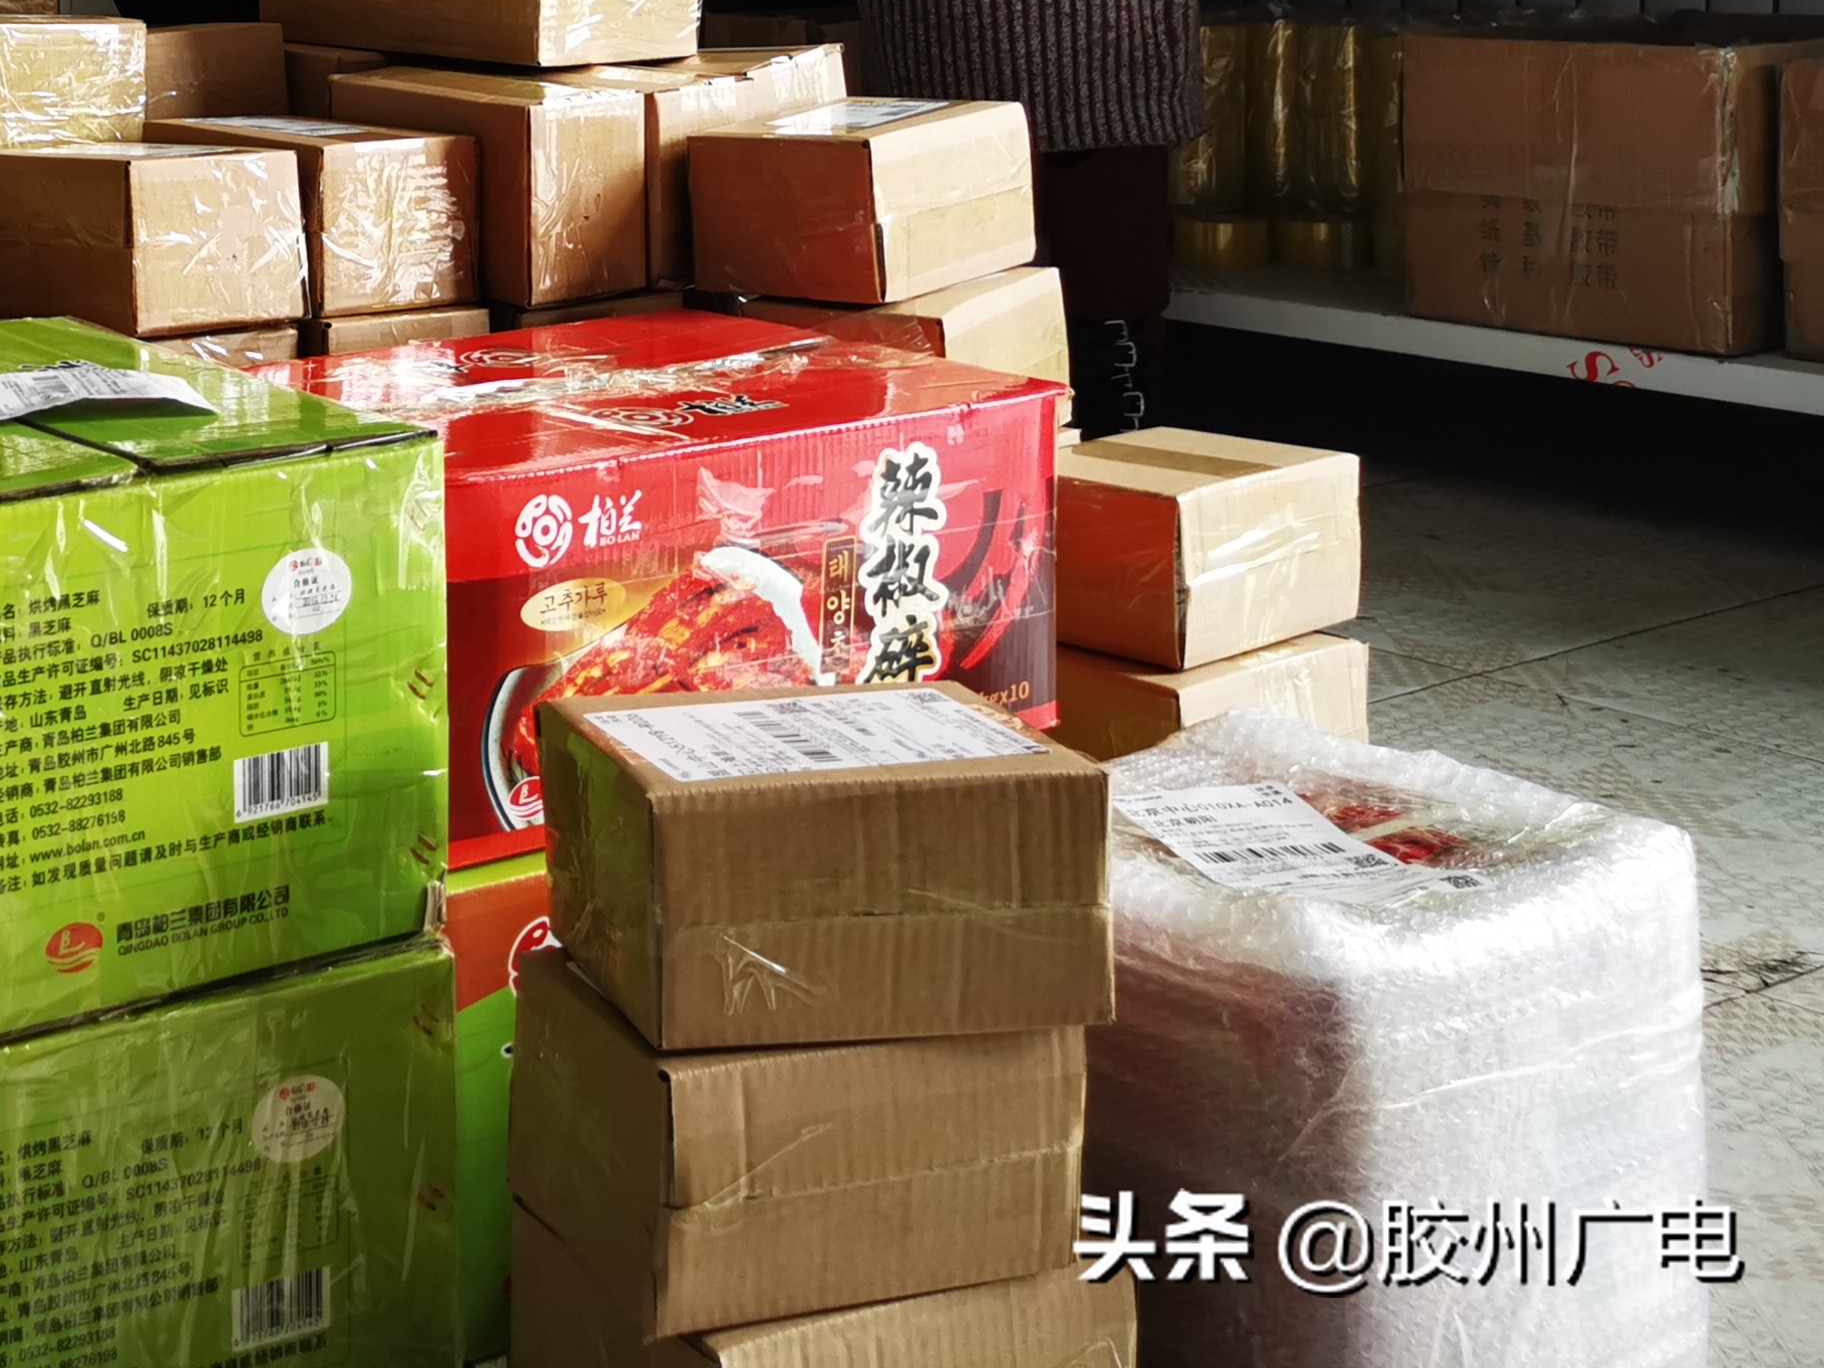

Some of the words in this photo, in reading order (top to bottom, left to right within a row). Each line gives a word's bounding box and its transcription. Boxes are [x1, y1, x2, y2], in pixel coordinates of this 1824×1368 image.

[578, 489, 642, 548] 柏兰
[539, 582, 608, 614] 고추가루
[90, 630, 126, 649] Q/BL
[131, 622, 172, 642] 0008S
[132, 629, 263, 663] SC11437028114498
[123, 677, 229, 712] 生产日期：见标识
[116, 884, 290, 943] 青岛柏兰集团有限公司
[117, 932, 168, 957] QINGDAO
[209, 914, 247, 935] GROUP
